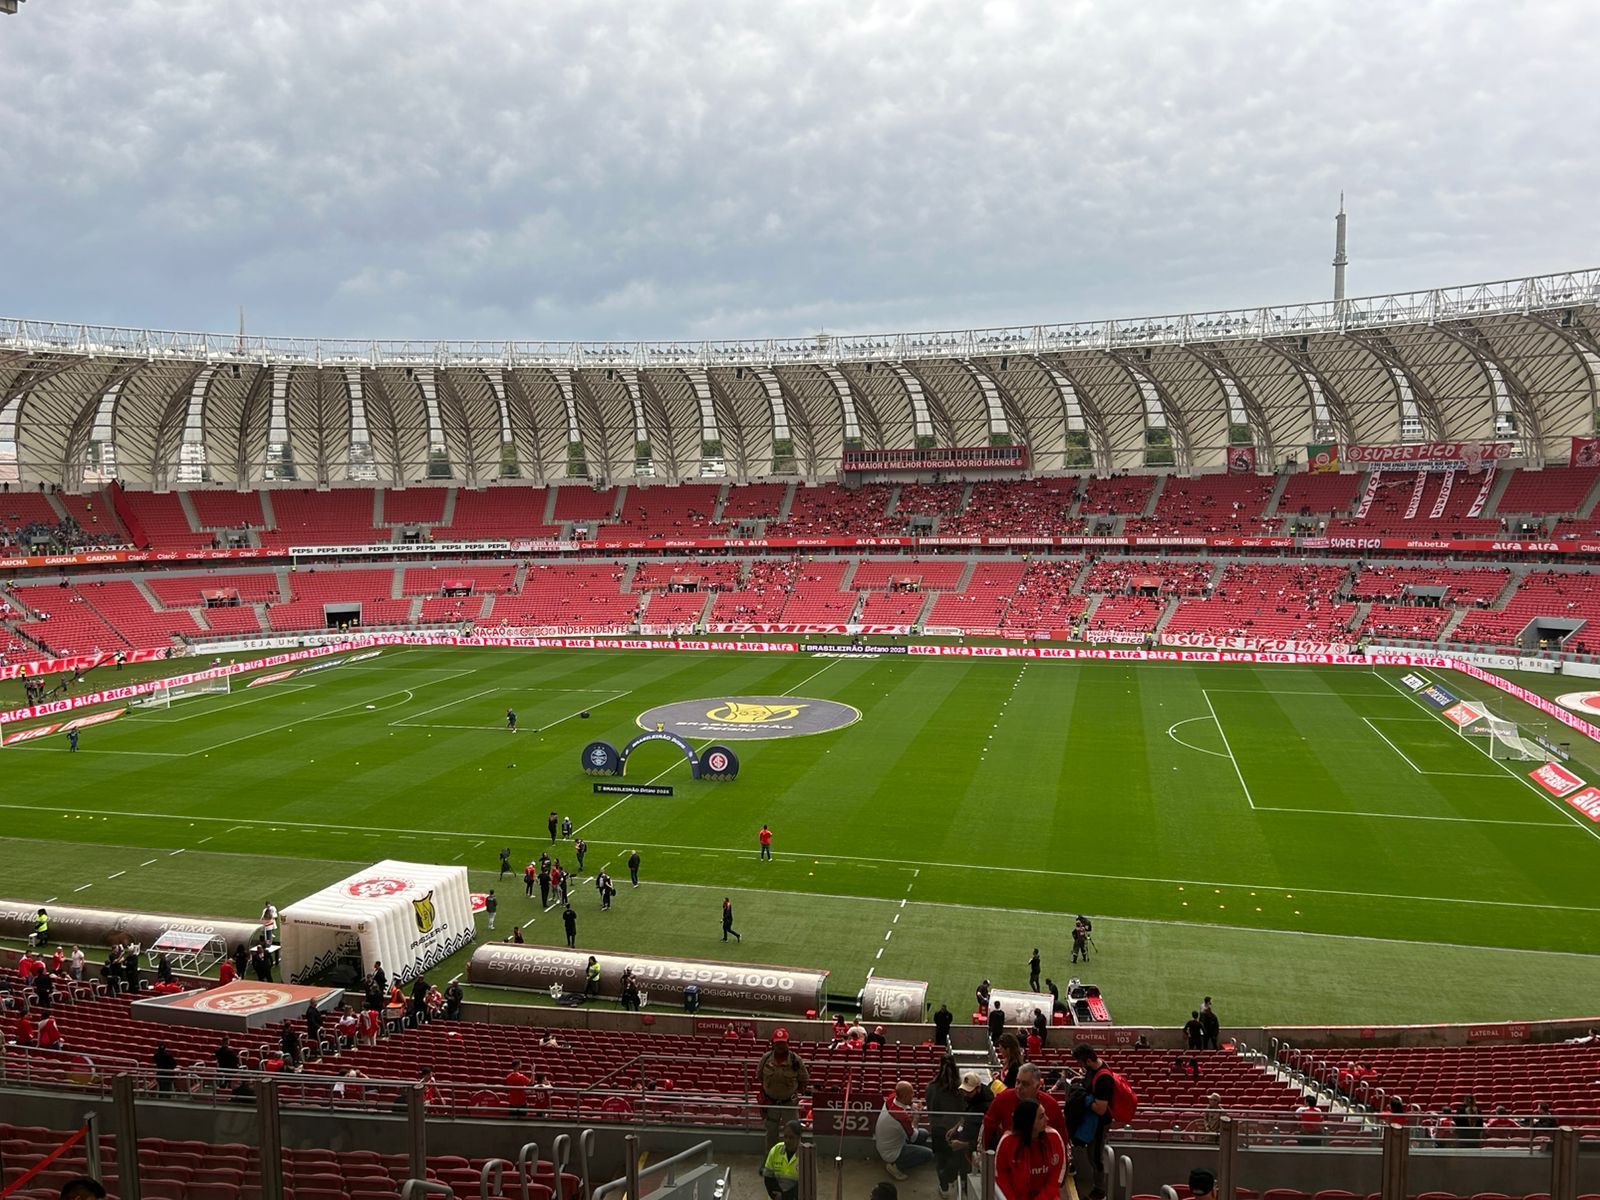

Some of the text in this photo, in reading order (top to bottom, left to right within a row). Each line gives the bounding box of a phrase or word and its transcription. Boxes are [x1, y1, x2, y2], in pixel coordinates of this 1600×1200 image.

[1364, 444, 1455, 460] SUPER FICO
[983, 459, 1015, 467] GRANDE
[1214, 538, 1291, 546] Claro Claro Claro
[1330, 538, 1356, 549] SUPER
[1357, 538, 1381, 549] FICO
[45, 556, 78, 565] GAUCHA
[86, 554, 118, 562] GAUCHA
[128, 553, 149, 561] Claro
[157, 552, 178, 560] Claro
[557, 625, 627, 635] INDEPENDENTE
[243, 640, 272, 649] SEJA
[279, 639, 295, 647] UM
[459, 638, 481, 646] alfa
[514, 639, 535, 647] alfa
[568, 640, 590, 649] alfa
[625, 640, 647, 648] alfa
[681, 641, 705, 649] alfa
[740, 643, 763, 651] alfa
[807, 641, 862, 653] BRASILEIRÃO
[864, 642, 889, 653] Betano
[1181, 635, 1332, 654] SUPER FICO 1977
[910, 645, 937, 654] alfa
[975, 647, 1002, 656] alfa
[1043, 649, 1071, 657] alfa
[1113, 650, 1142, 659] alfa
[1186, 652, 1216, 661] alfa
[1260, 655, 1289, 663] alfa
[1335, 655, 1367, 664] alfa
[1415, 657, 1445, 667] alfa
[39, 699, 68, 714] alfa
[74, 692, 103, 706] alfa
[106, 685, 133, 698] alfa
[491, 951, 502, 960] A
[563, 957, 582, 969] DE
[488, 961, 578, 979] ESTAR PERTO.
[667, 967, 795, 990] 3392.1000
[698, 1022, 726, 1030] CENTRAL
[1076, 1033, 1106, 1041] CENTRAL
[826, 1099, 873, 1112] SETOR
[832, 1113, 869, 1131] 352
